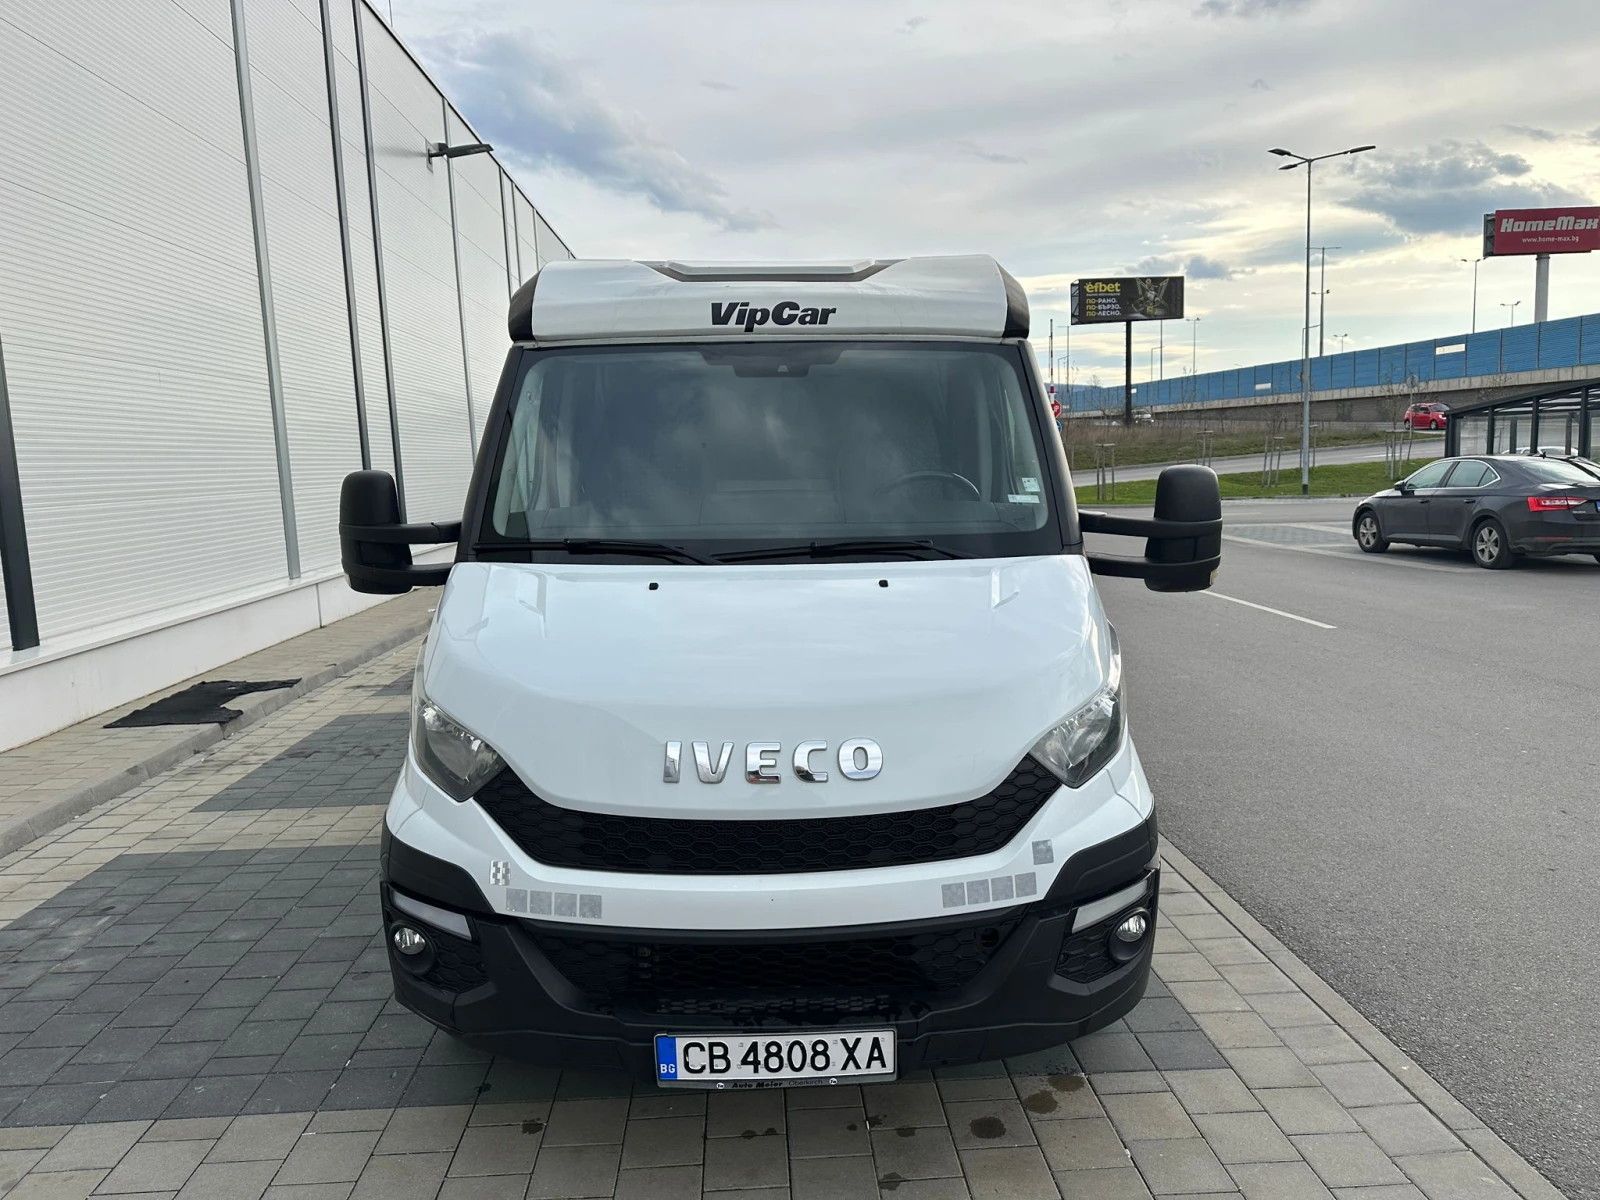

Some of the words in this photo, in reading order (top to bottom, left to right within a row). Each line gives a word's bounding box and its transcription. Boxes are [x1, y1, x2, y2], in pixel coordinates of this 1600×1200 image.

[1500, 216, 1599, 233] HomeMax
[1085, 282, 1121, 293] efbet
[711, 301, 837, 333] VipCar
[663, 738, 883, 783] IVECO
[683, 1041, 731, 1074] CB
[740, 1039, 831, 1073] 4808
[840, 1037, 887, 1070] XA
[660, 1064, 676, 1074] BG
[788, 1079, 823, 1087] Oberkirch
